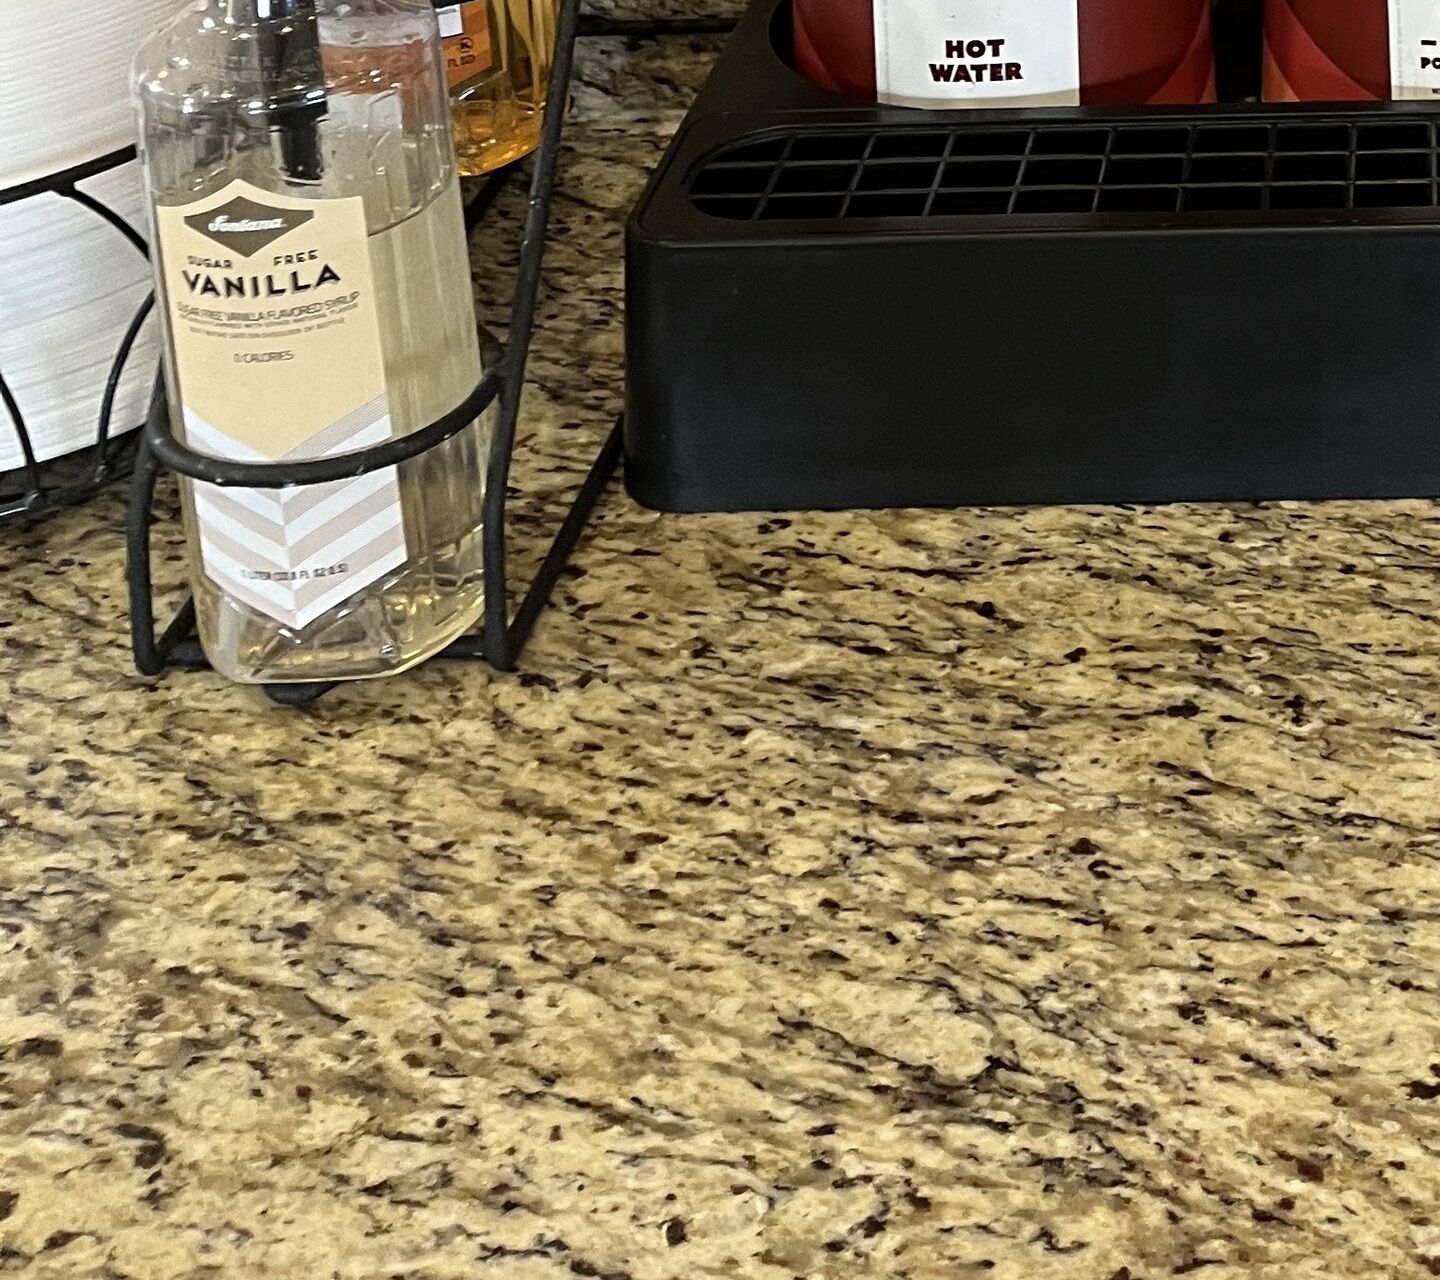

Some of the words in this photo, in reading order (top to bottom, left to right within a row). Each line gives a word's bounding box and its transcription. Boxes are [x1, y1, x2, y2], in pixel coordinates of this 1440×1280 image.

[945, 38, 1005, 59] HOT
[928, 61, 1024, 83] WATER
[187, 255, 234, 269] SUGAR
[273, 249, 319, 267] FREE
[182, 263, 341, 299] VANILLA
